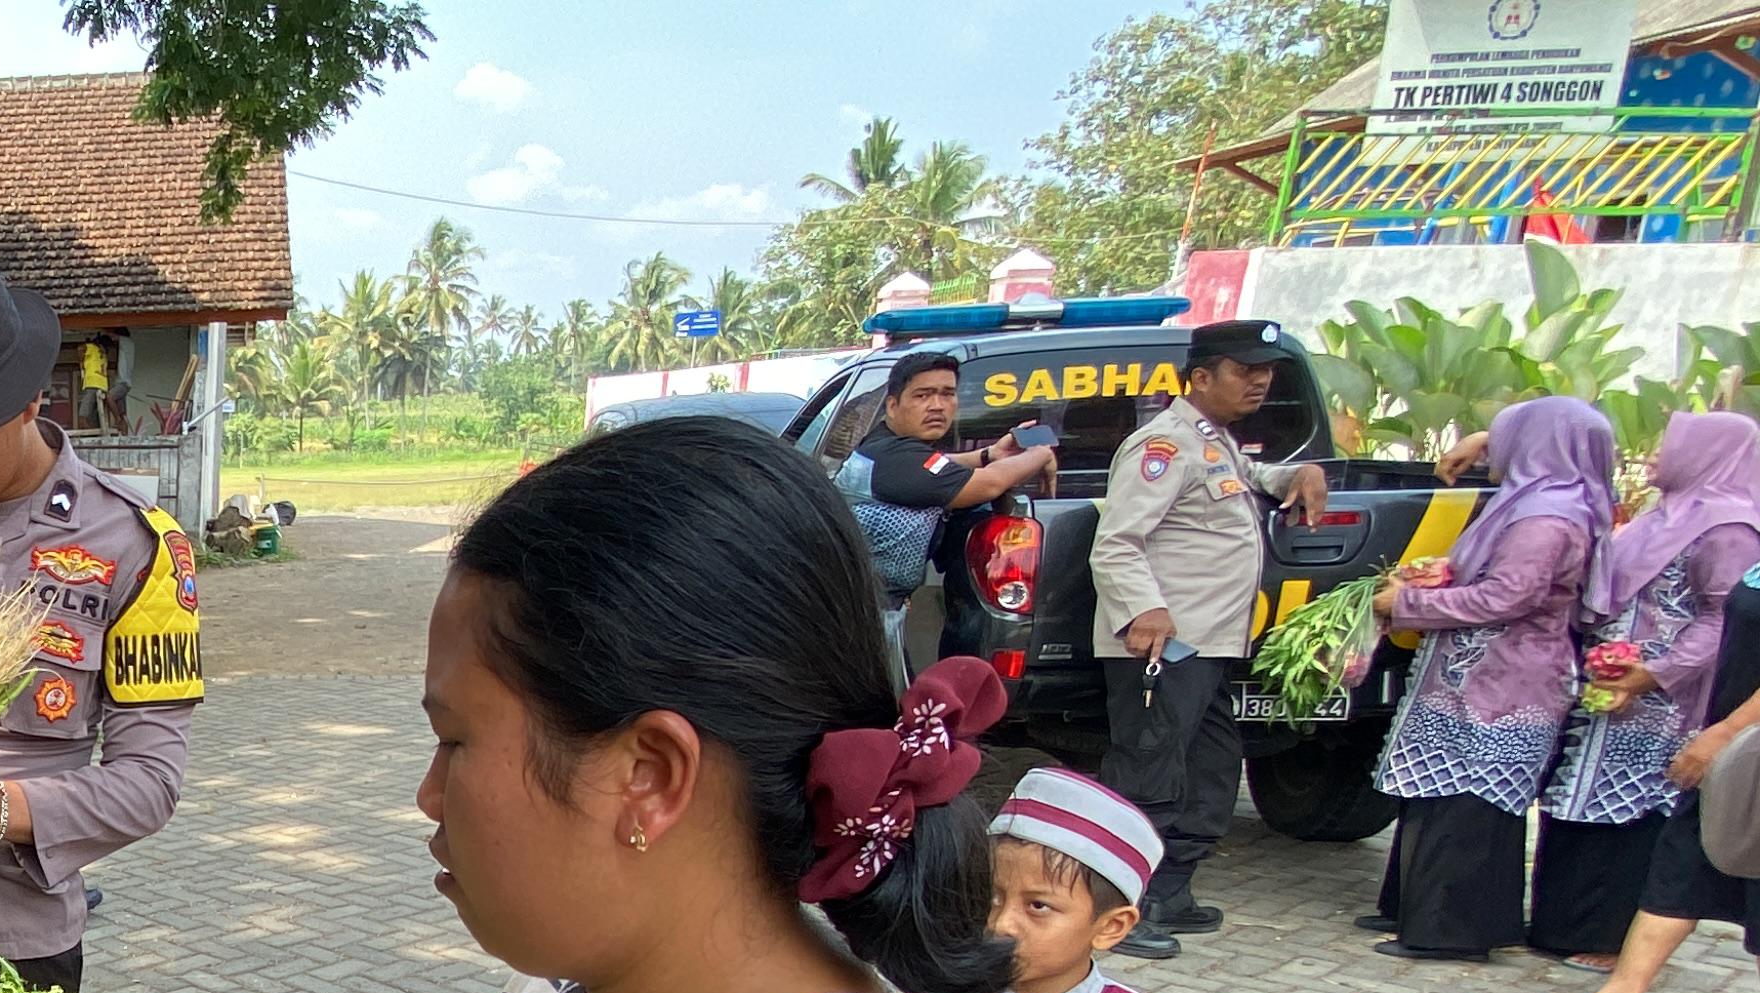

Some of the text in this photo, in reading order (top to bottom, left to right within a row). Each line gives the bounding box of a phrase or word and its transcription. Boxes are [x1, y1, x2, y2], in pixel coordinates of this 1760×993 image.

[1393, 80, 1604, 108] TK PERTIWI 4 SONGGON
[984, 362, 1192, 407] SABHA
